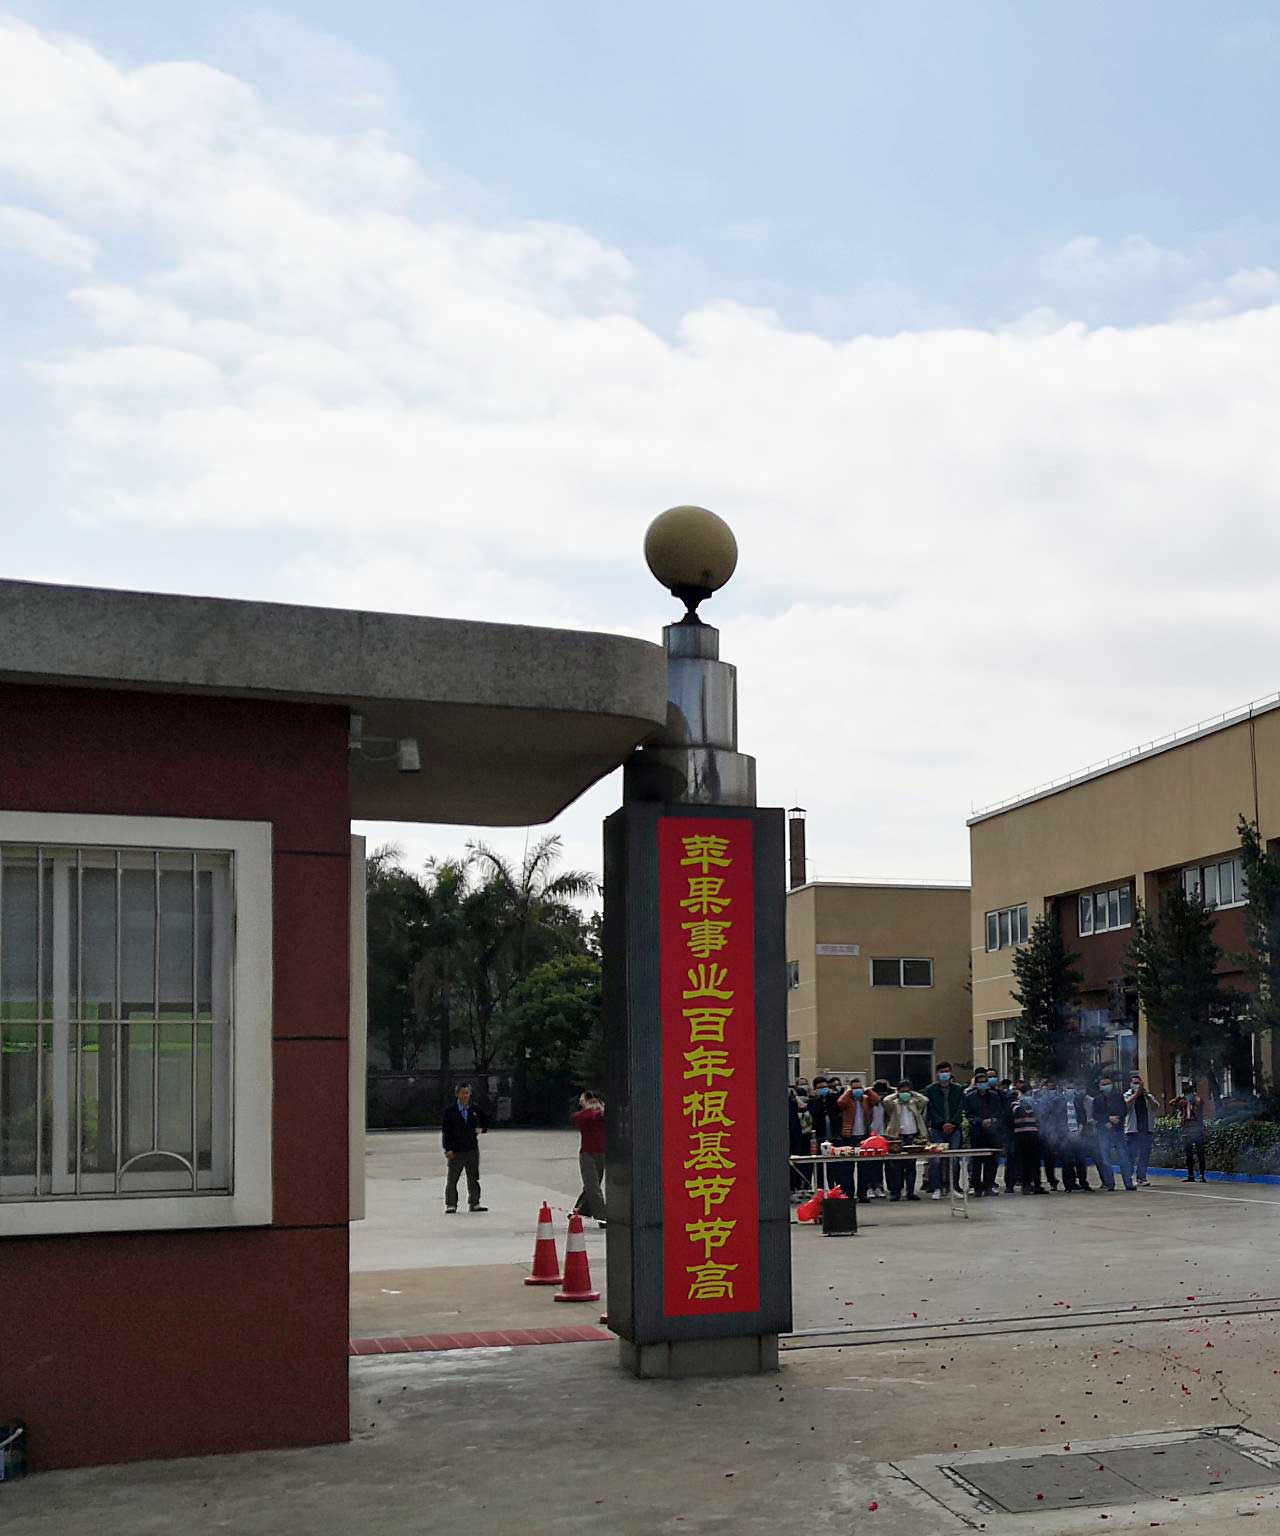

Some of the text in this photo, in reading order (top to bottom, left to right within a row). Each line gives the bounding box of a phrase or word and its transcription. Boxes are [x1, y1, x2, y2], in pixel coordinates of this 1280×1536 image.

[680, 834, 738, 1301] 苹果事业百年根基节节高
